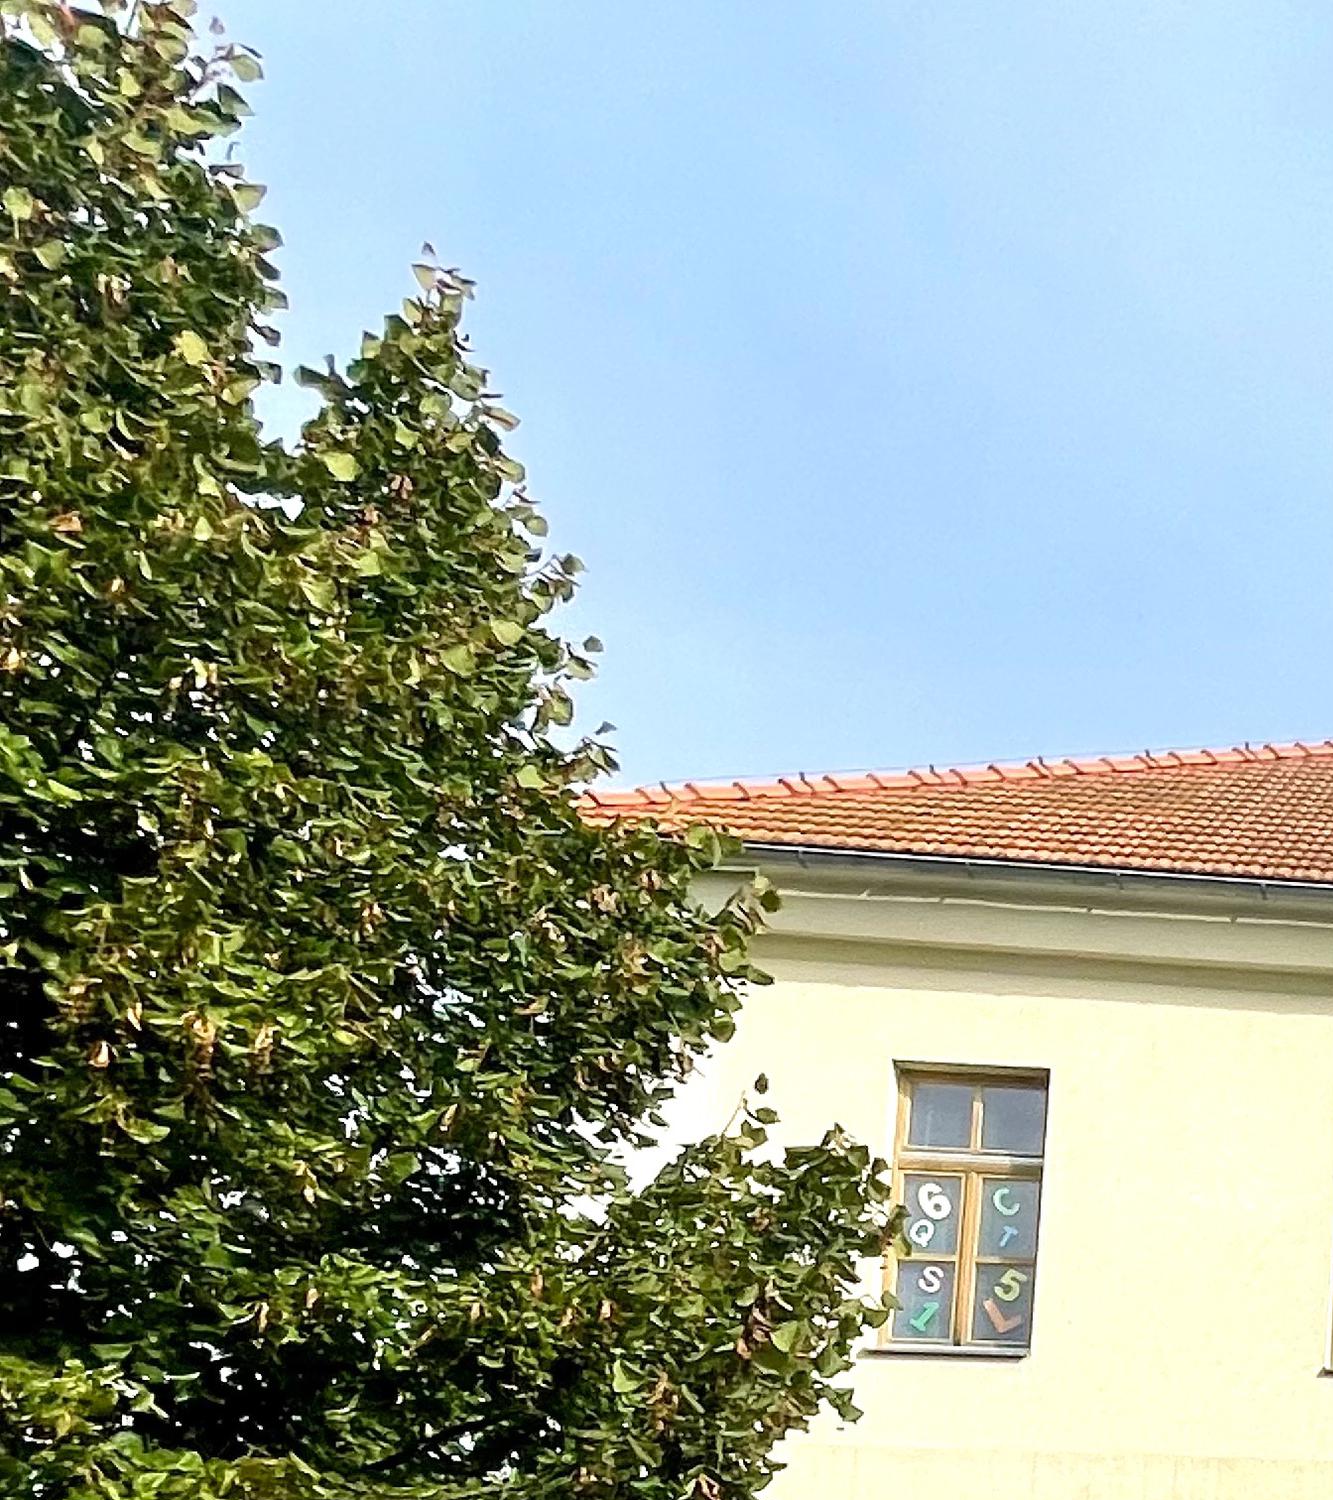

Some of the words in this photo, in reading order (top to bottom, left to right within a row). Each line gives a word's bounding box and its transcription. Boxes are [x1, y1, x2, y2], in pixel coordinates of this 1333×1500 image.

[918, 1182, 952, 1221] 6
[993, 1187, 1020, 1216] C
[910, 1219, 935, 1248] Q
[918, 1266, 945, 1293] S
[909, 1302, 940, 1332] 1
